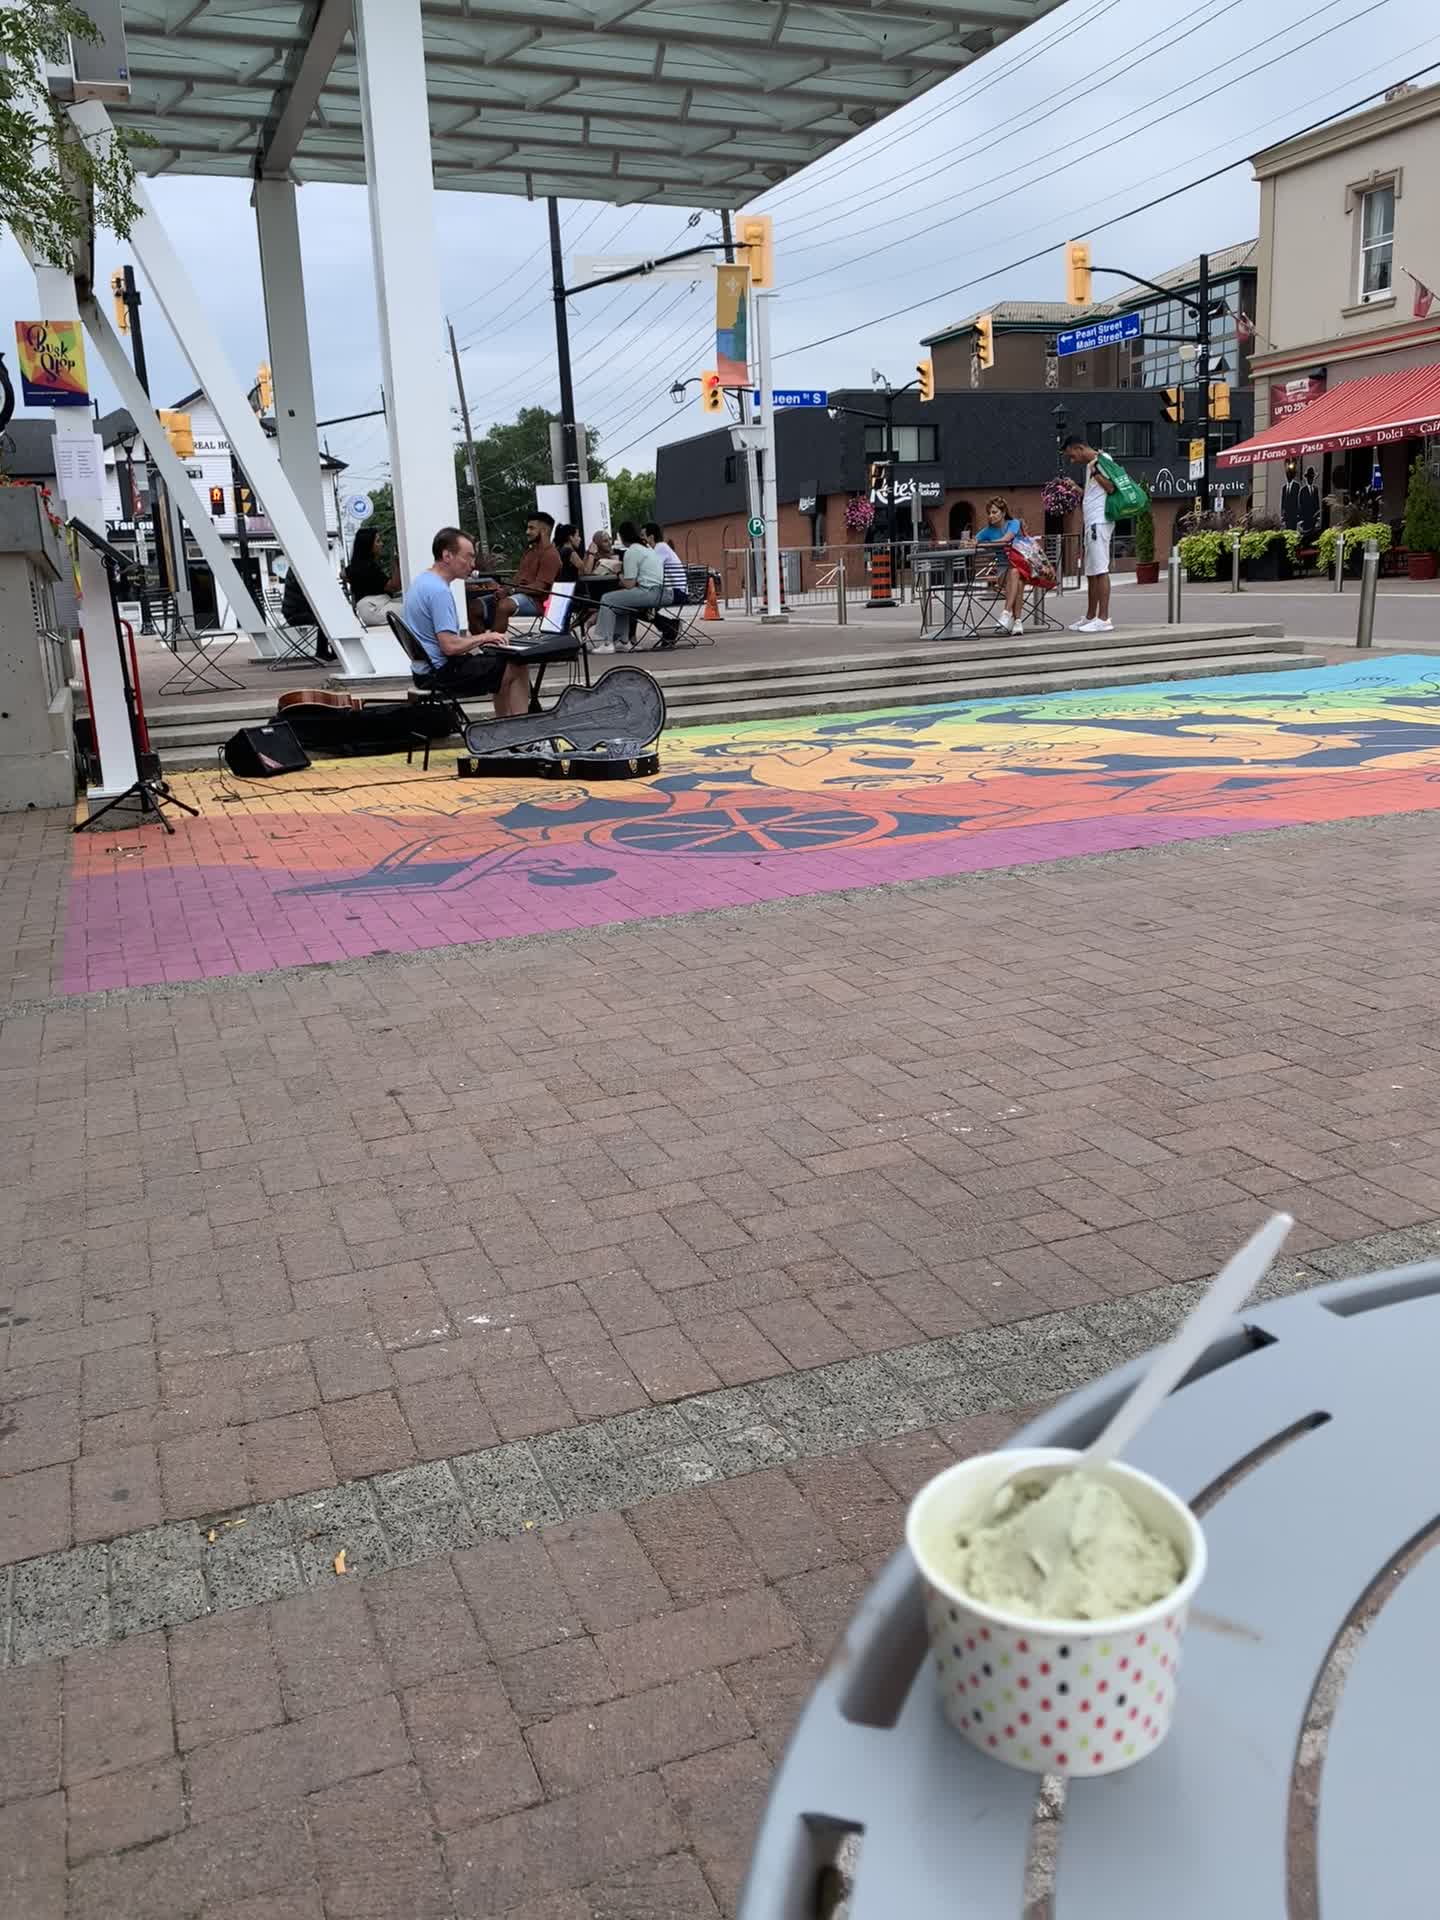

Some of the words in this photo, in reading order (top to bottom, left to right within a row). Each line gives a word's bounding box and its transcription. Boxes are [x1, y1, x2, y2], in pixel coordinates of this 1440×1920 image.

[26, 322, 68, 357] Busk
[1076, 327, 1097, 340] Pearl
[1098, 321, 1123, 333] Street
[1076, 338, 1096, 350] Main
[1098, 331, 1123, 345] Street
[41, 353, 76, 382] Stop
[813, 393, 821, 404] S
[1274, 406, 1283, 415] UP
[1284, 404, 1293, 413] TO
[1229, 453, 1251, 465] Pizza
[1253, 451, 1261, 461] al
[1261, 448, 1287, 460] Forno
[1301, 442, 1324, 454] Pasta
[1338, 437, 1362, 447] Vino
[1377, 427, 1404, 441] Dolci
[753, 520, 761, 531] P
